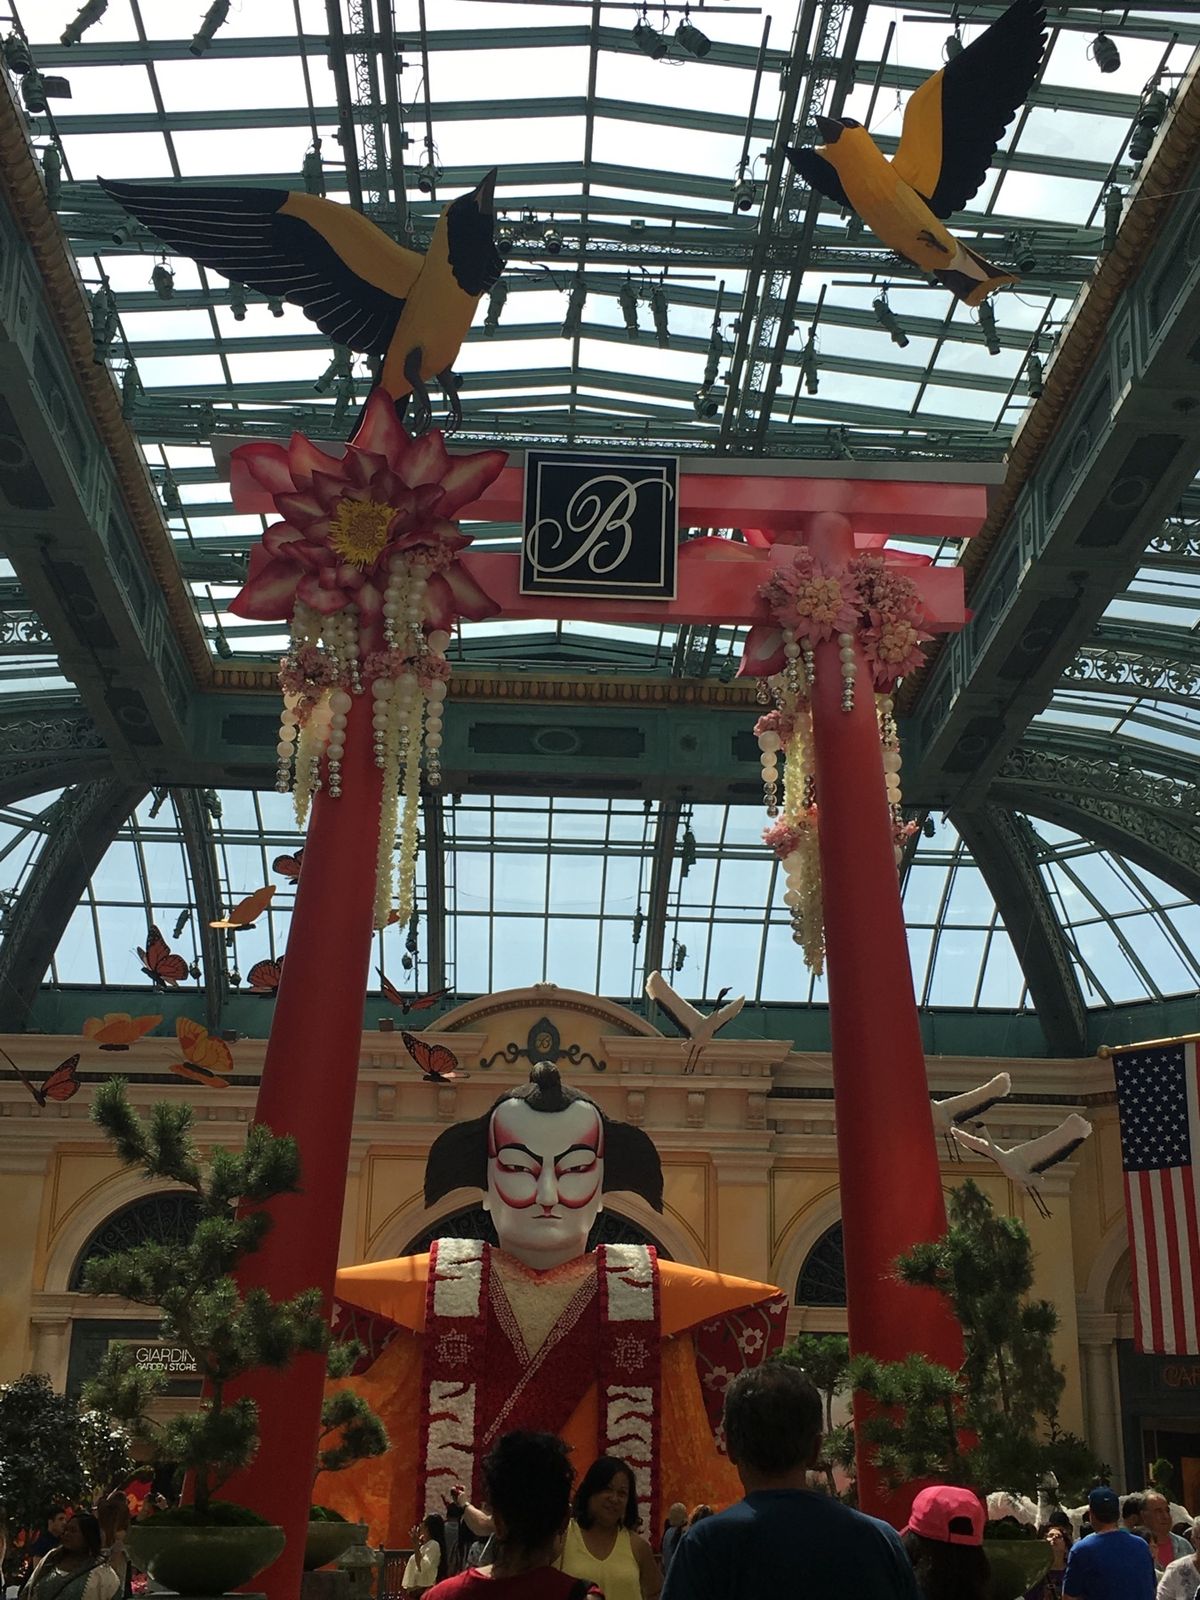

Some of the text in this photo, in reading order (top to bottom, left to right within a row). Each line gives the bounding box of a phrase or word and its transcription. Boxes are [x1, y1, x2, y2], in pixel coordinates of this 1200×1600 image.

[525, 474, 674, 574] B
[136, 1362, 197, 1372] GARDEN STORE
